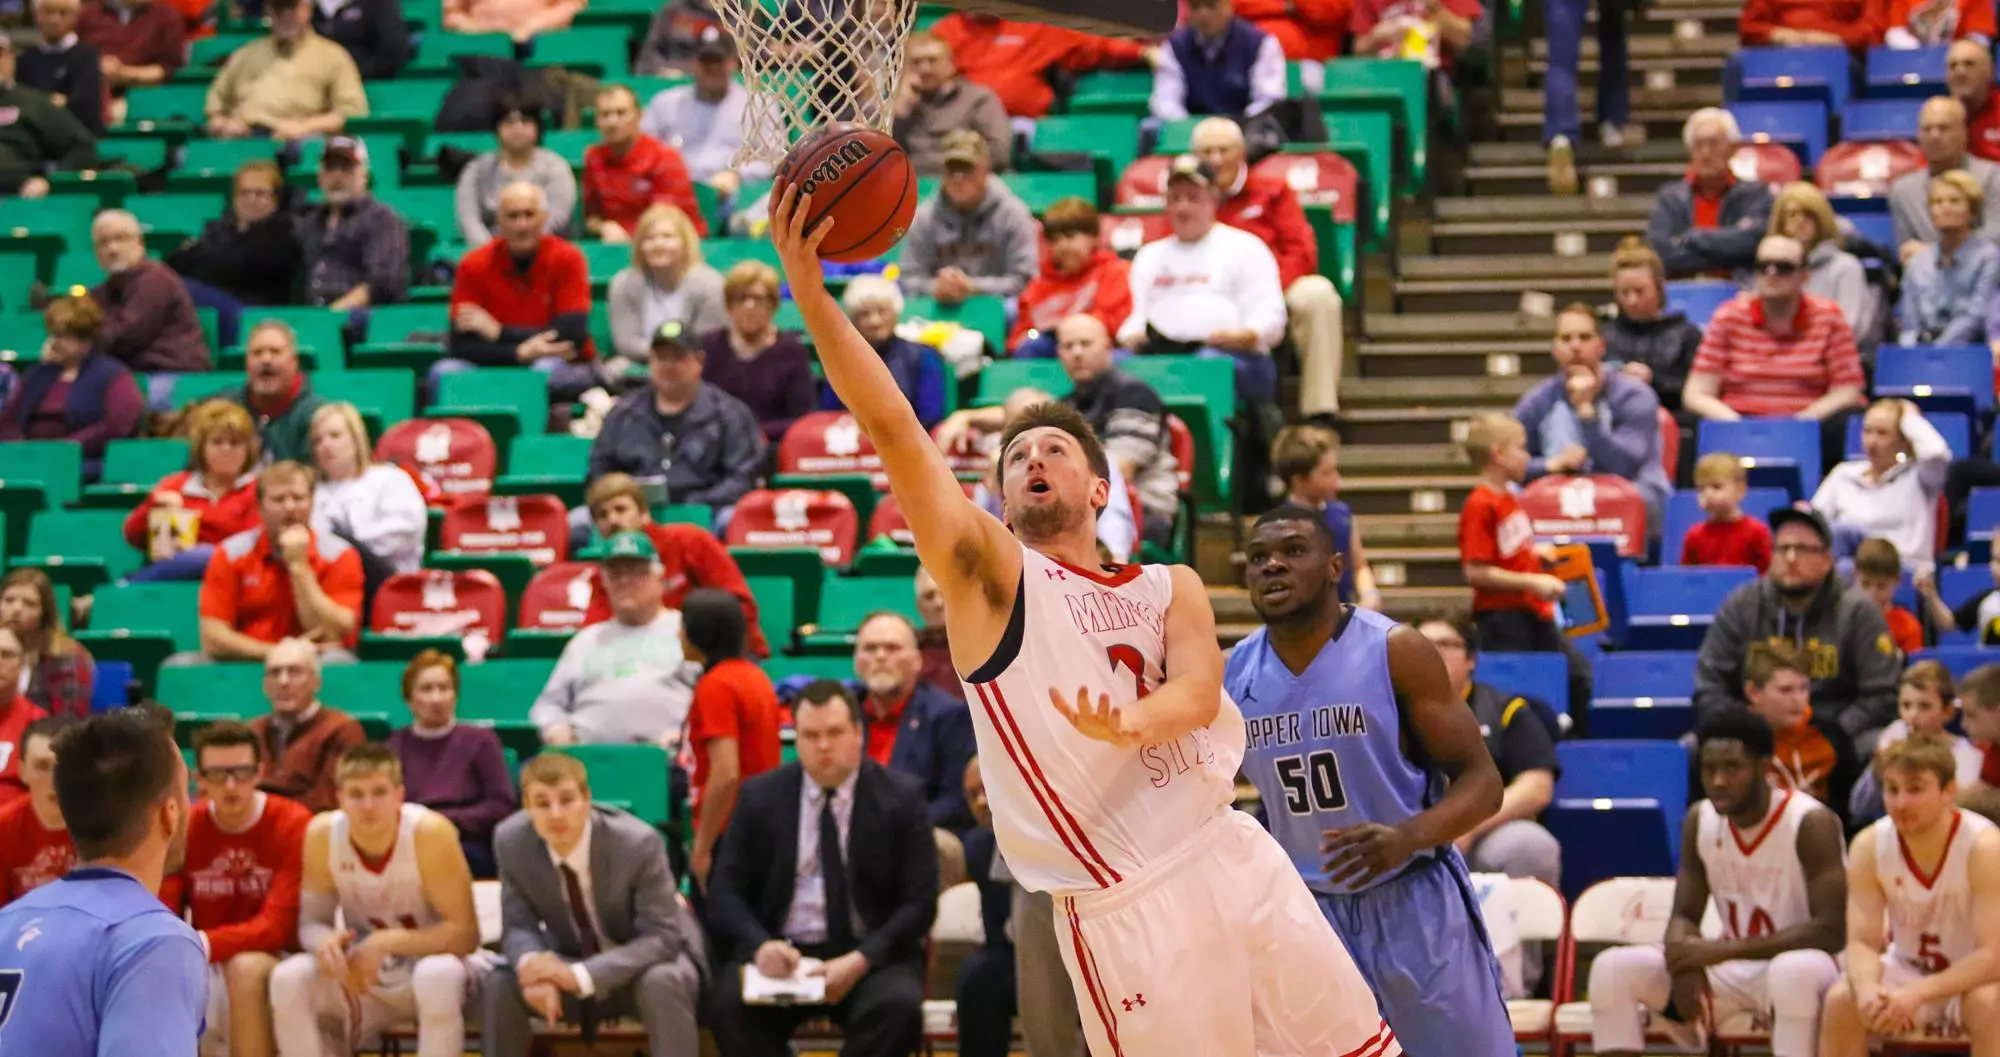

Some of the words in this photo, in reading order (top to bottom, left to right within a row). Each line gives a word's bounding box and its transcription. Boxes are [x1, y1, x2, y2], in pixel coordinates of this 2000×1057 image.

[1310, 703, 1367, 740] IOWA
[1274, 749, 1348, 816] 50
[1918, 932, 1952, 974] 5
